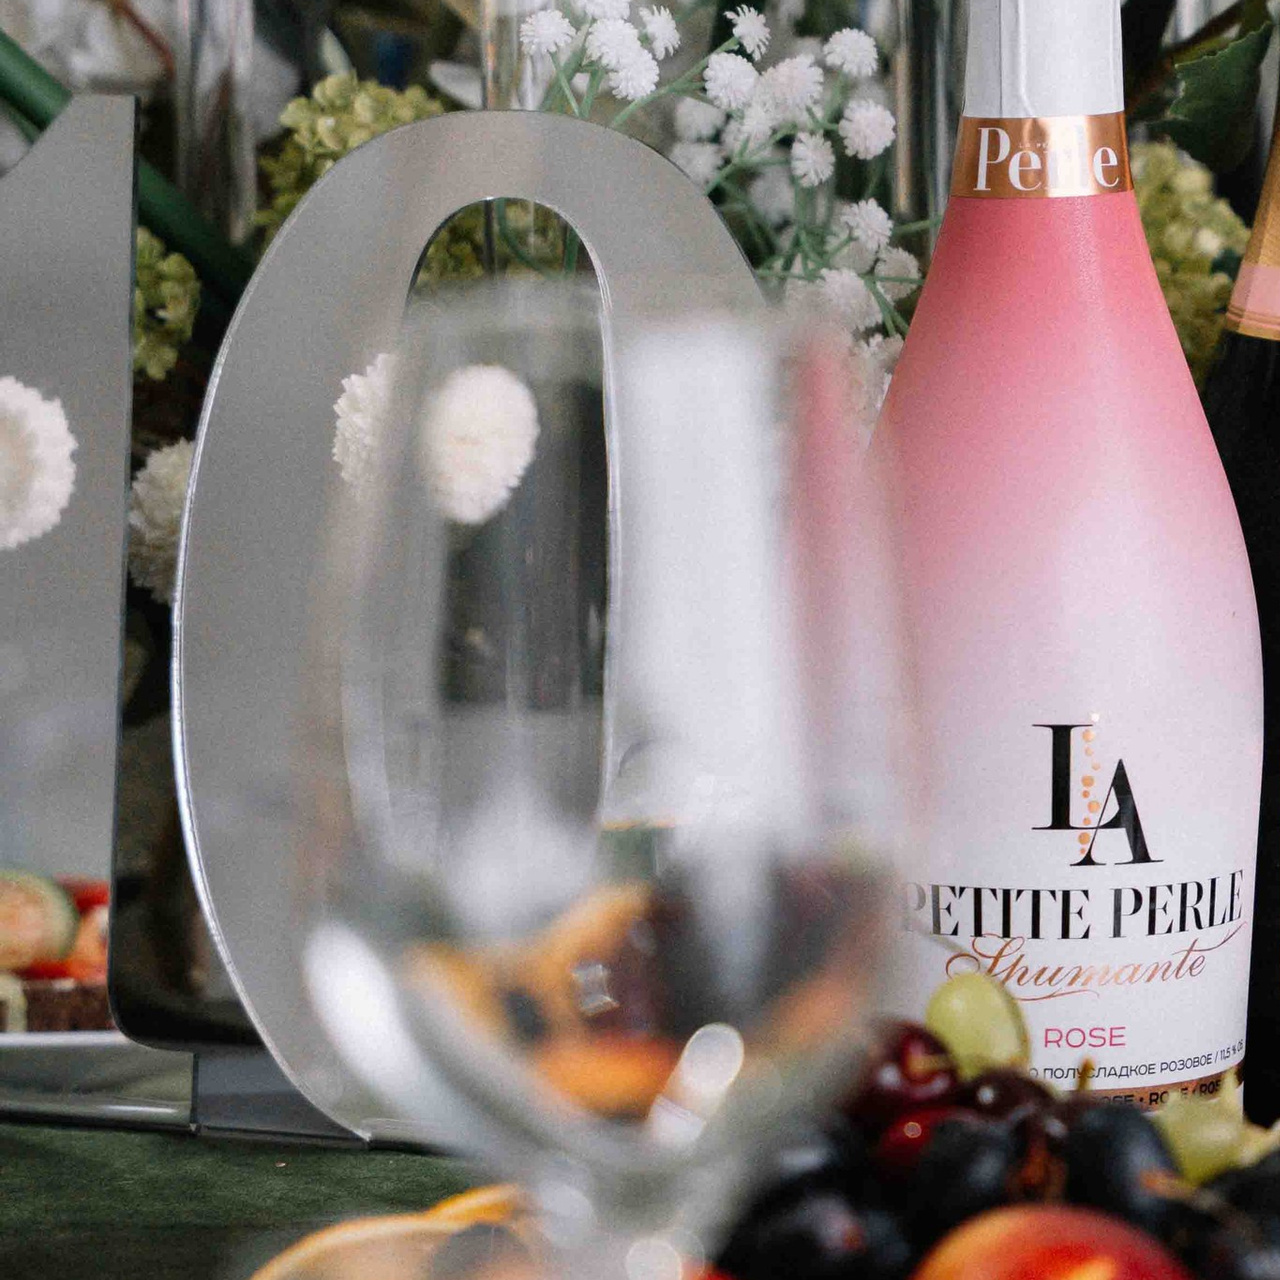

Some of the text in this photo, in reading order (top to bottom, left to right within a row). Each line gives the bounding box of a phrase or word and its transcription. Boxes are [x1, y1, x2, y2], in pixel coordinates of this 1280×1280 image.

[1108, 869, 1244, 938] PERLE
[945, 921, 1249, 1002] Spumante
[1044, 1026, 1127, 1048] ROSE
[1160, 1053, 1213, 1074] РОЗОВОЕ
